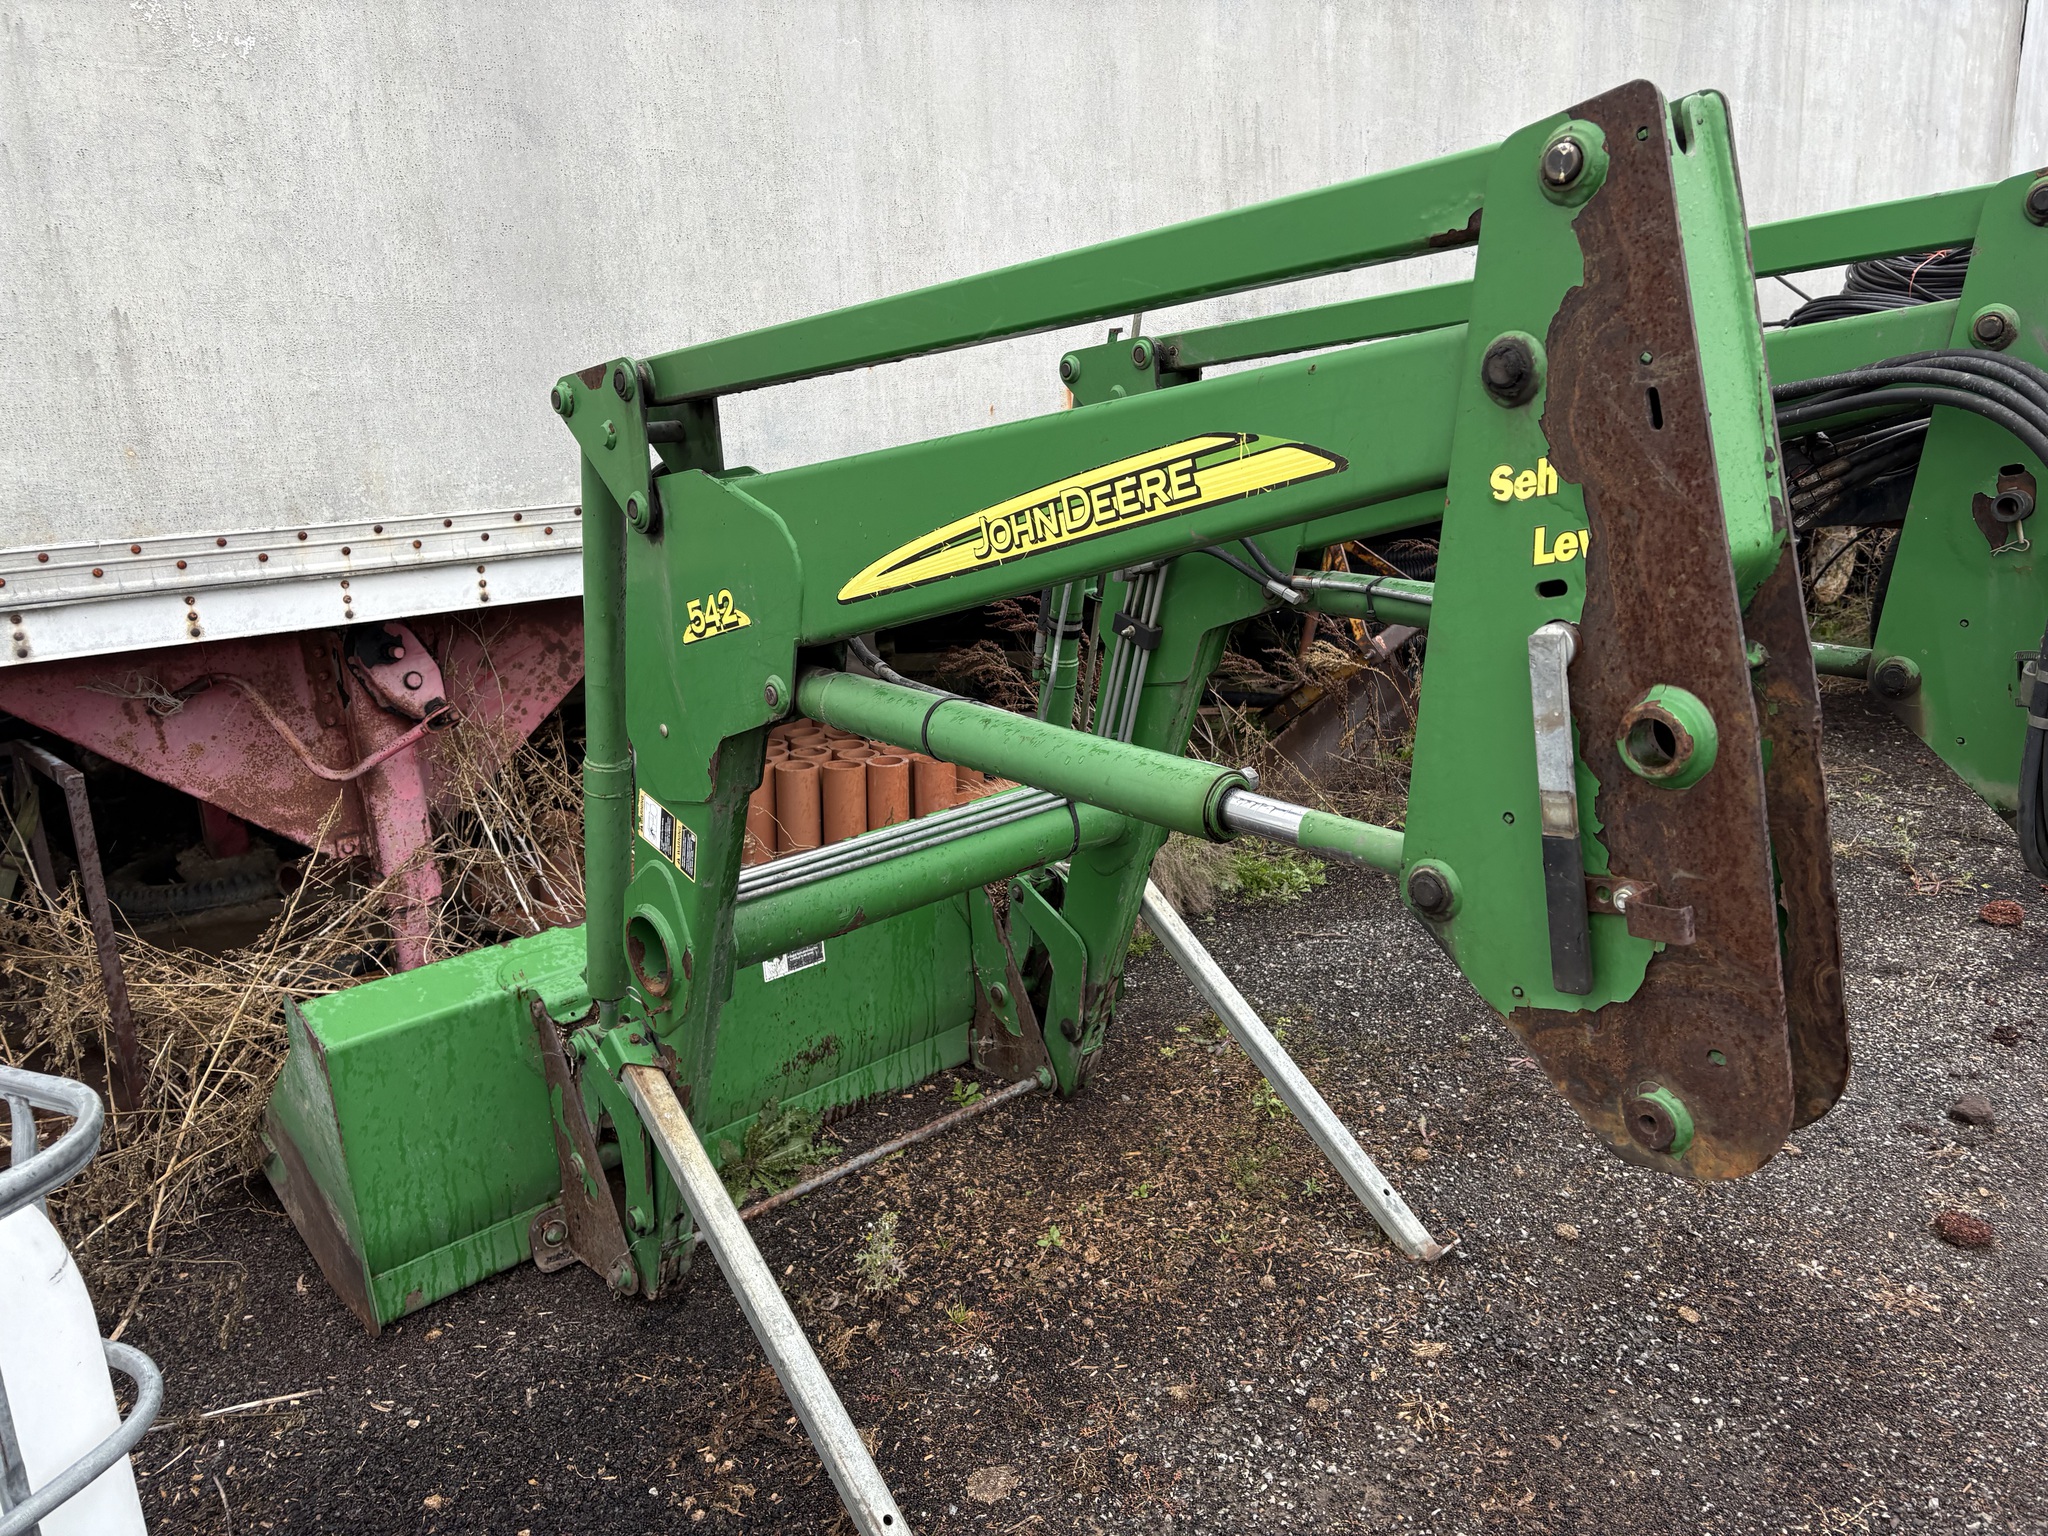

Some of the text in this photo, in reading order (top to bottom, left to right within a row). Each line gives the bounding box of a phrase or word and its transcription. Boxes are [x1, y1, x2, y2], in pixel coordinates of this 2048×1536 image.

[974, 458, 1202, 559] JOHN DEERE
[686, 588, 739, 638] 542
